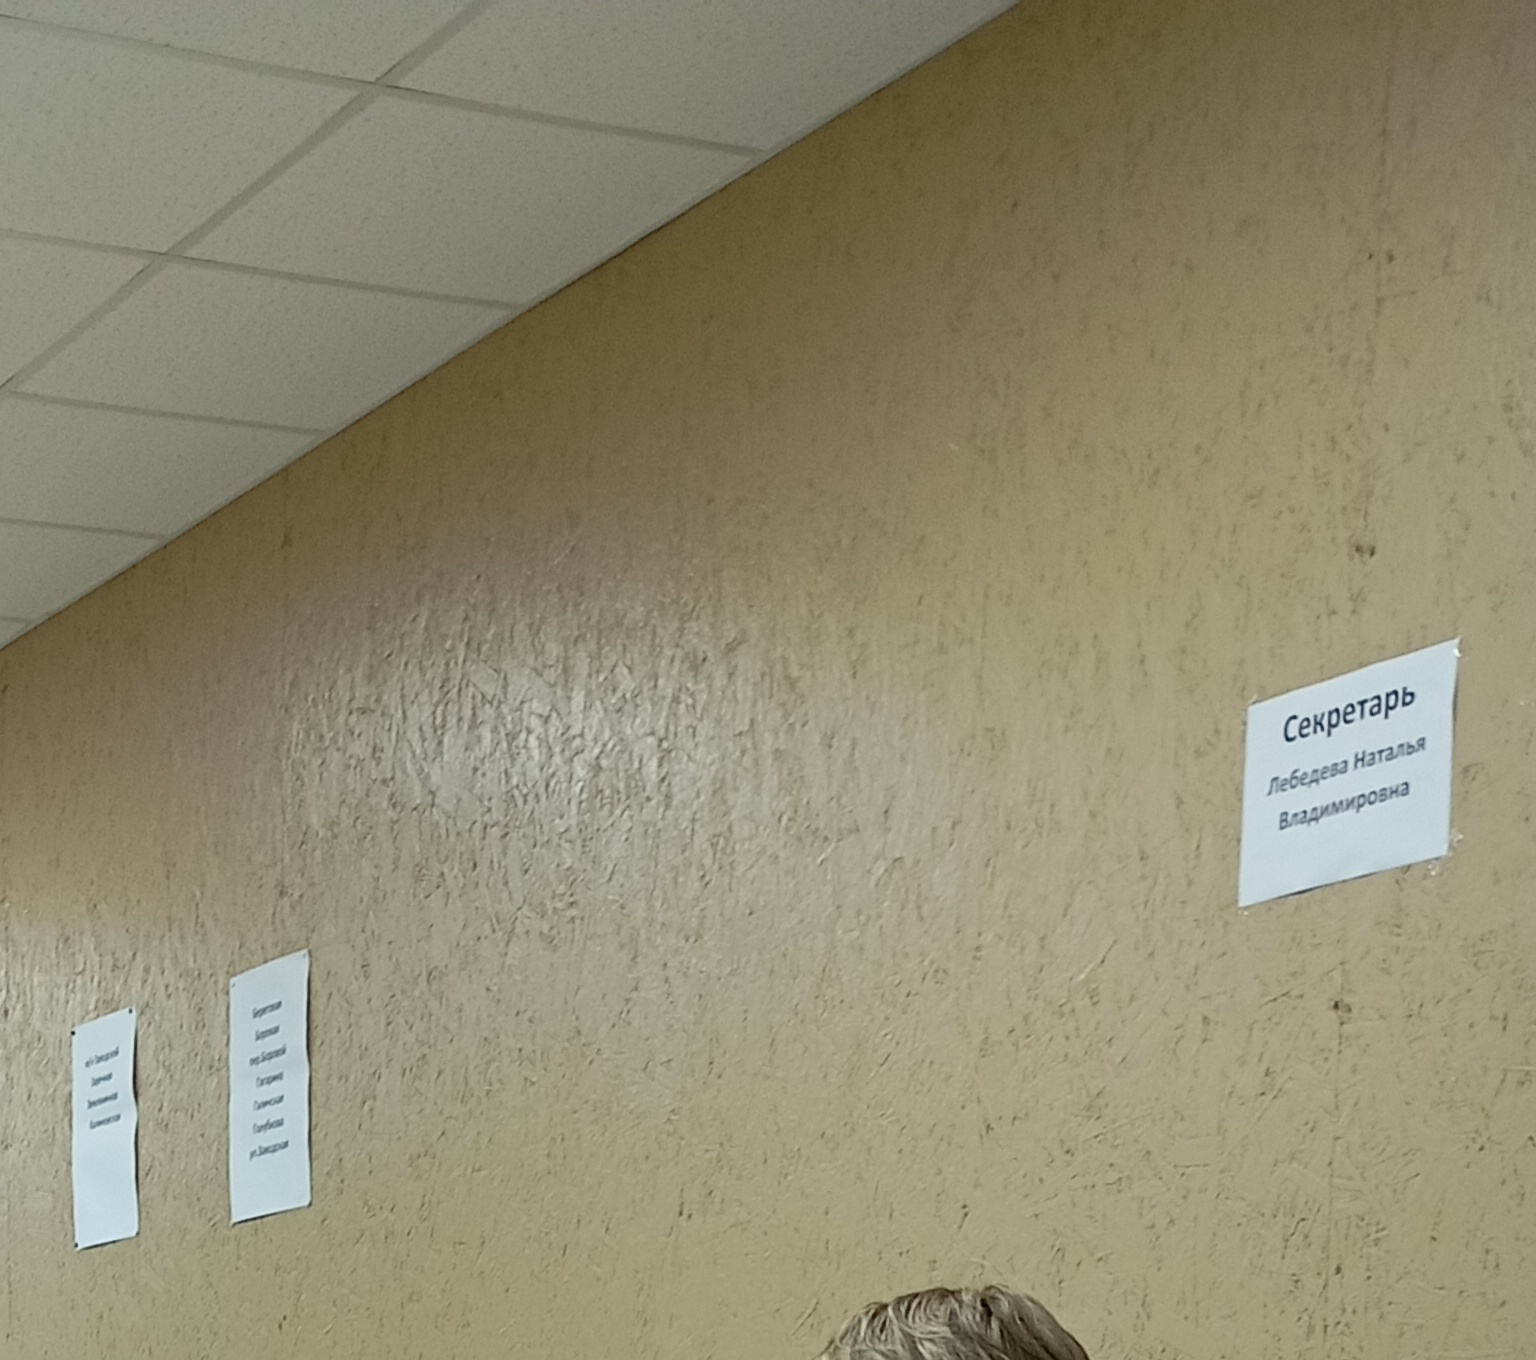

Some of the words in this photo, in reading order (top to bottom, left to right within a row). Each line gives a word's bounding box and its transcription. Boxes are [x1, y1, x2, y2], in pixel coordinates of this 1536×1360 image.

[1283, 685, 1416, 743] Секретарь
[1266, 758, 1348, 797] Лебедева
[1353, 736, 1426, 770] Наталья
[1278, 781, 1411, 831] Владимировна
